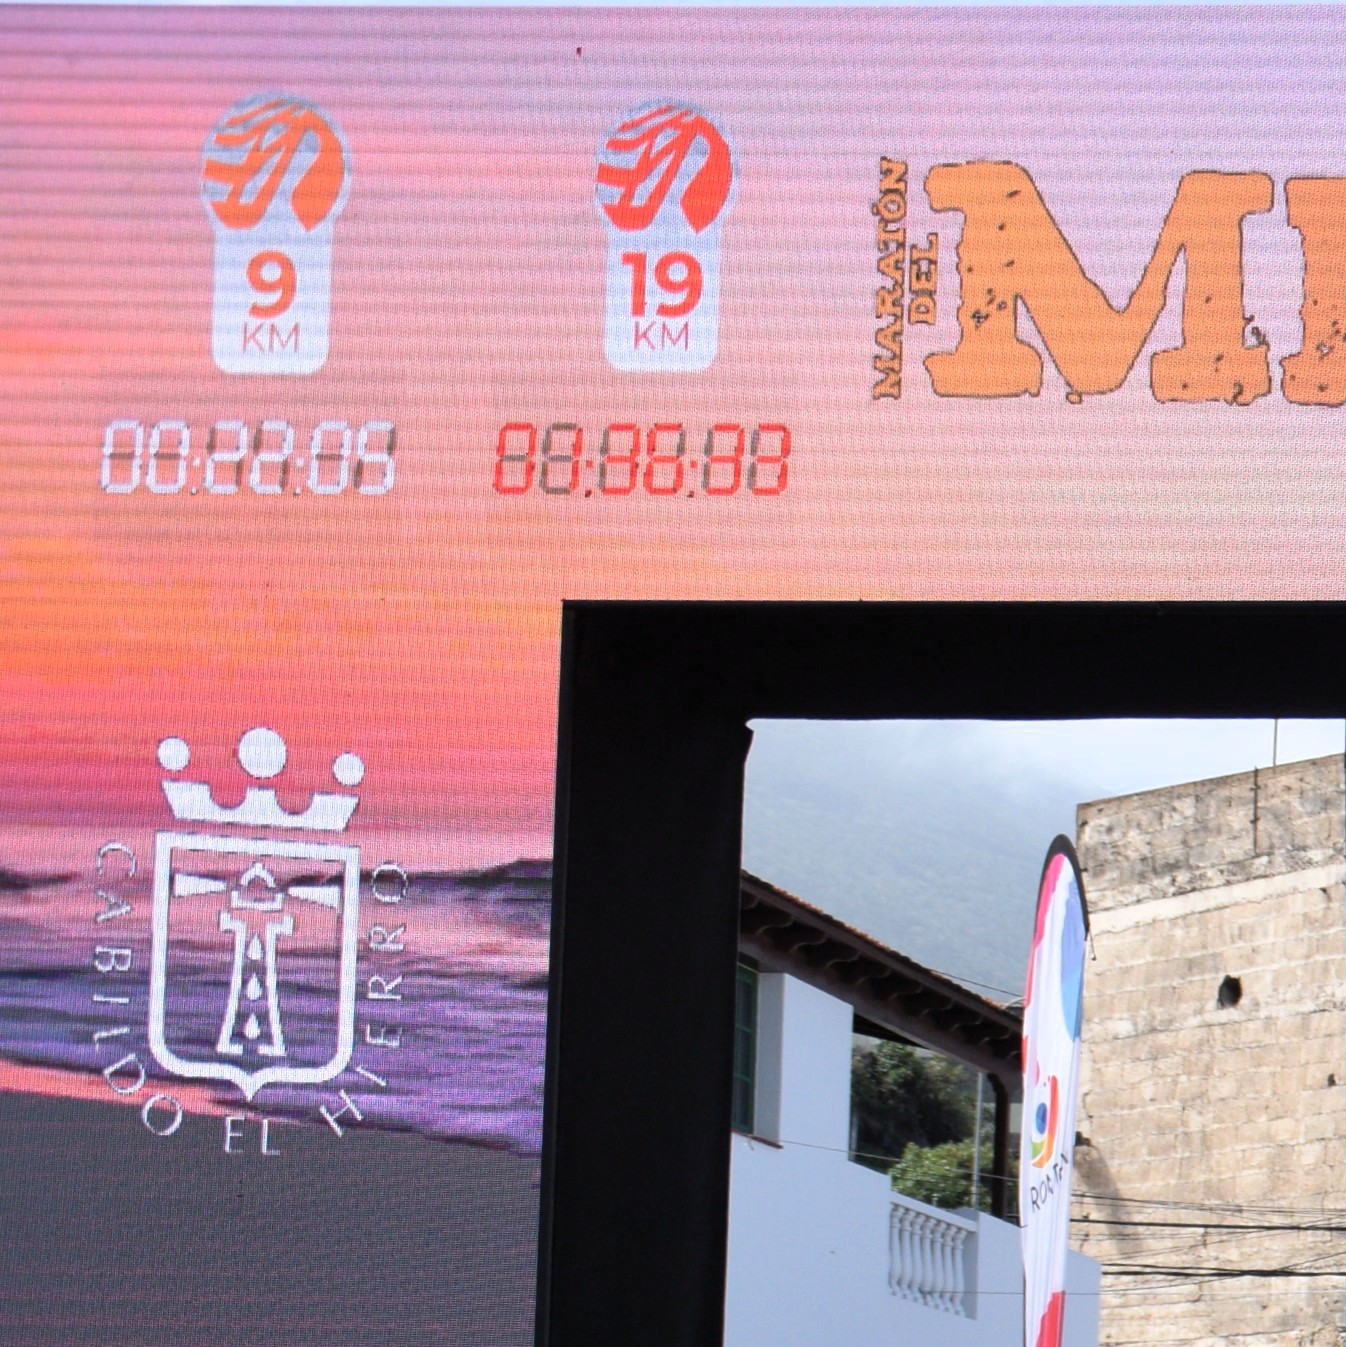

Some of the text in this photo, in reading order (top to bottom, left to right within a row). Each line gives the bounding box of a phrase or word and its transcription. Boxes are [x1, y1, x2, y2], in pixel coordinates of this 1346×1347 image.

[247, 252, 294, 318] 9
[622, 251, 704, 318] 19
[872, 156, 908, 399] MARATÓN
[908, 232, 938, 325] DEL
[242, 323, 301, 354] KM
[633, 322, 690, 351] KM
[100, 419, 396, 495] 00:22:05
[92, 842, 410, 1156] CABILDO EL HIERRO
